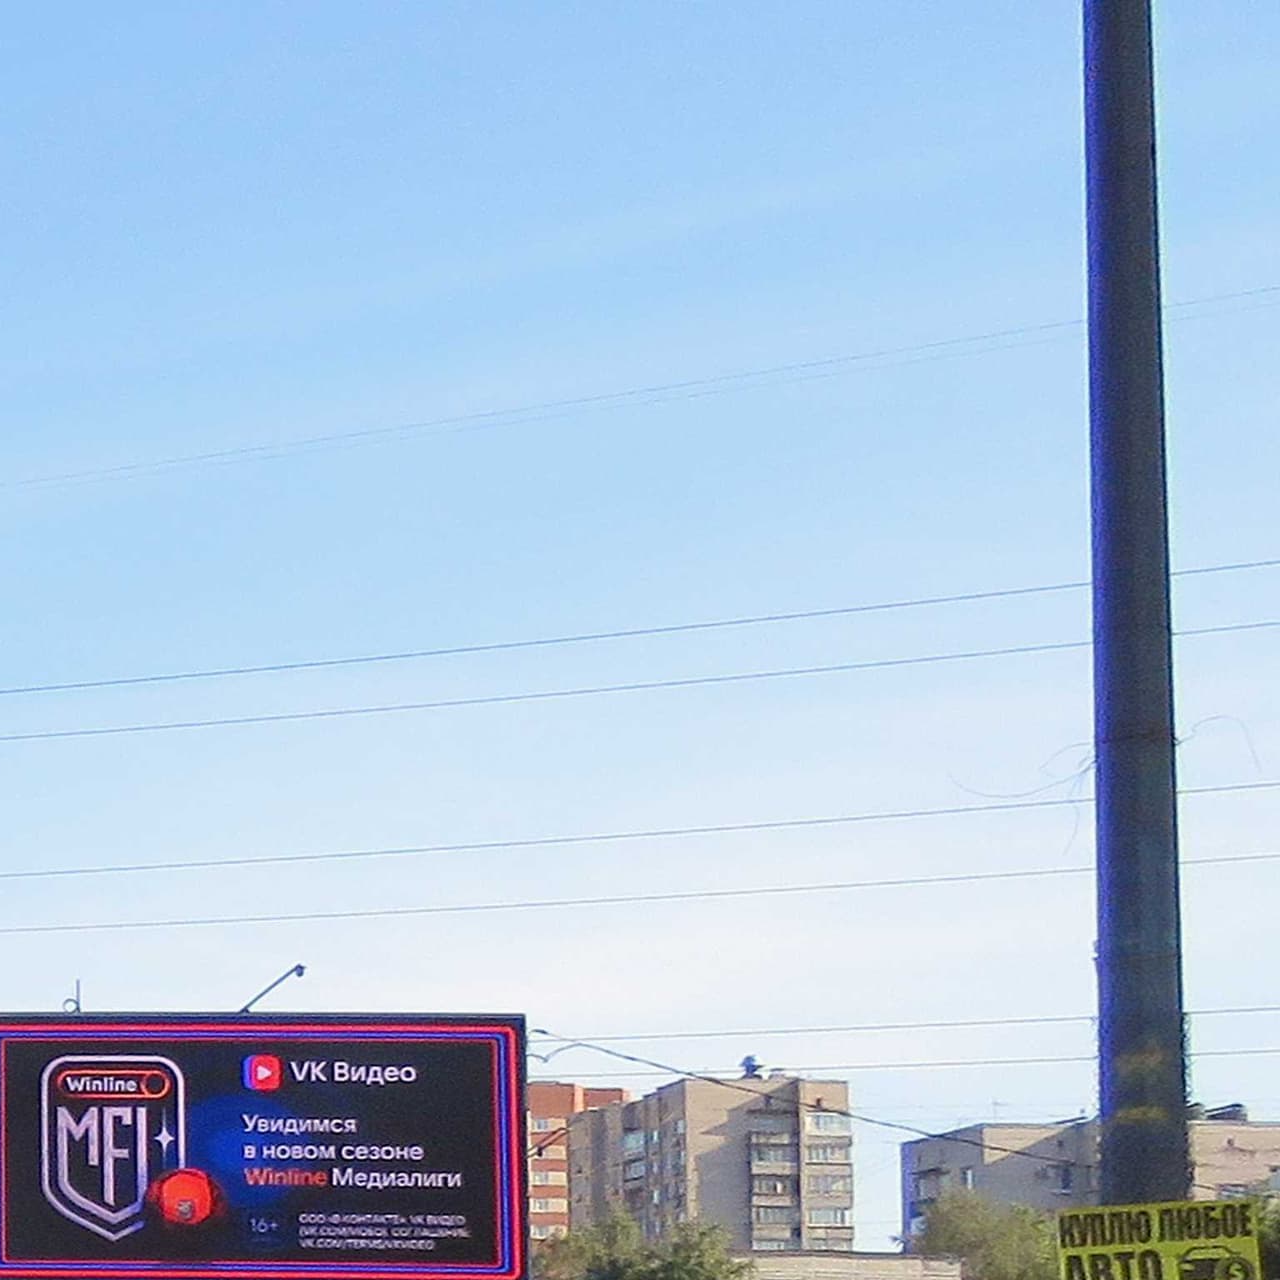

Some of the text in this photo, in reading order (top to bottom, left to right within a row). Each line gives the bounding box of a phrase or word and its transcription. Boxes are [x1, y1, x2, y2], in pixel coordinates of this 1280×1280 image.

[291, 1061, 417, 1086] VK Видео
[66, 1076, 138, 1093] Winline
[242, 1114, 358, 1134] Увидимся
[243, 1145, 425, 1160] в новом сезоне
[244, 1167, 462, 1190] Winline Медиалиги
[250, 1217, 279, 1233] 16+
[1060, 1203, 1253, 1248] КУПЛЮ ЛЮБОЕ
